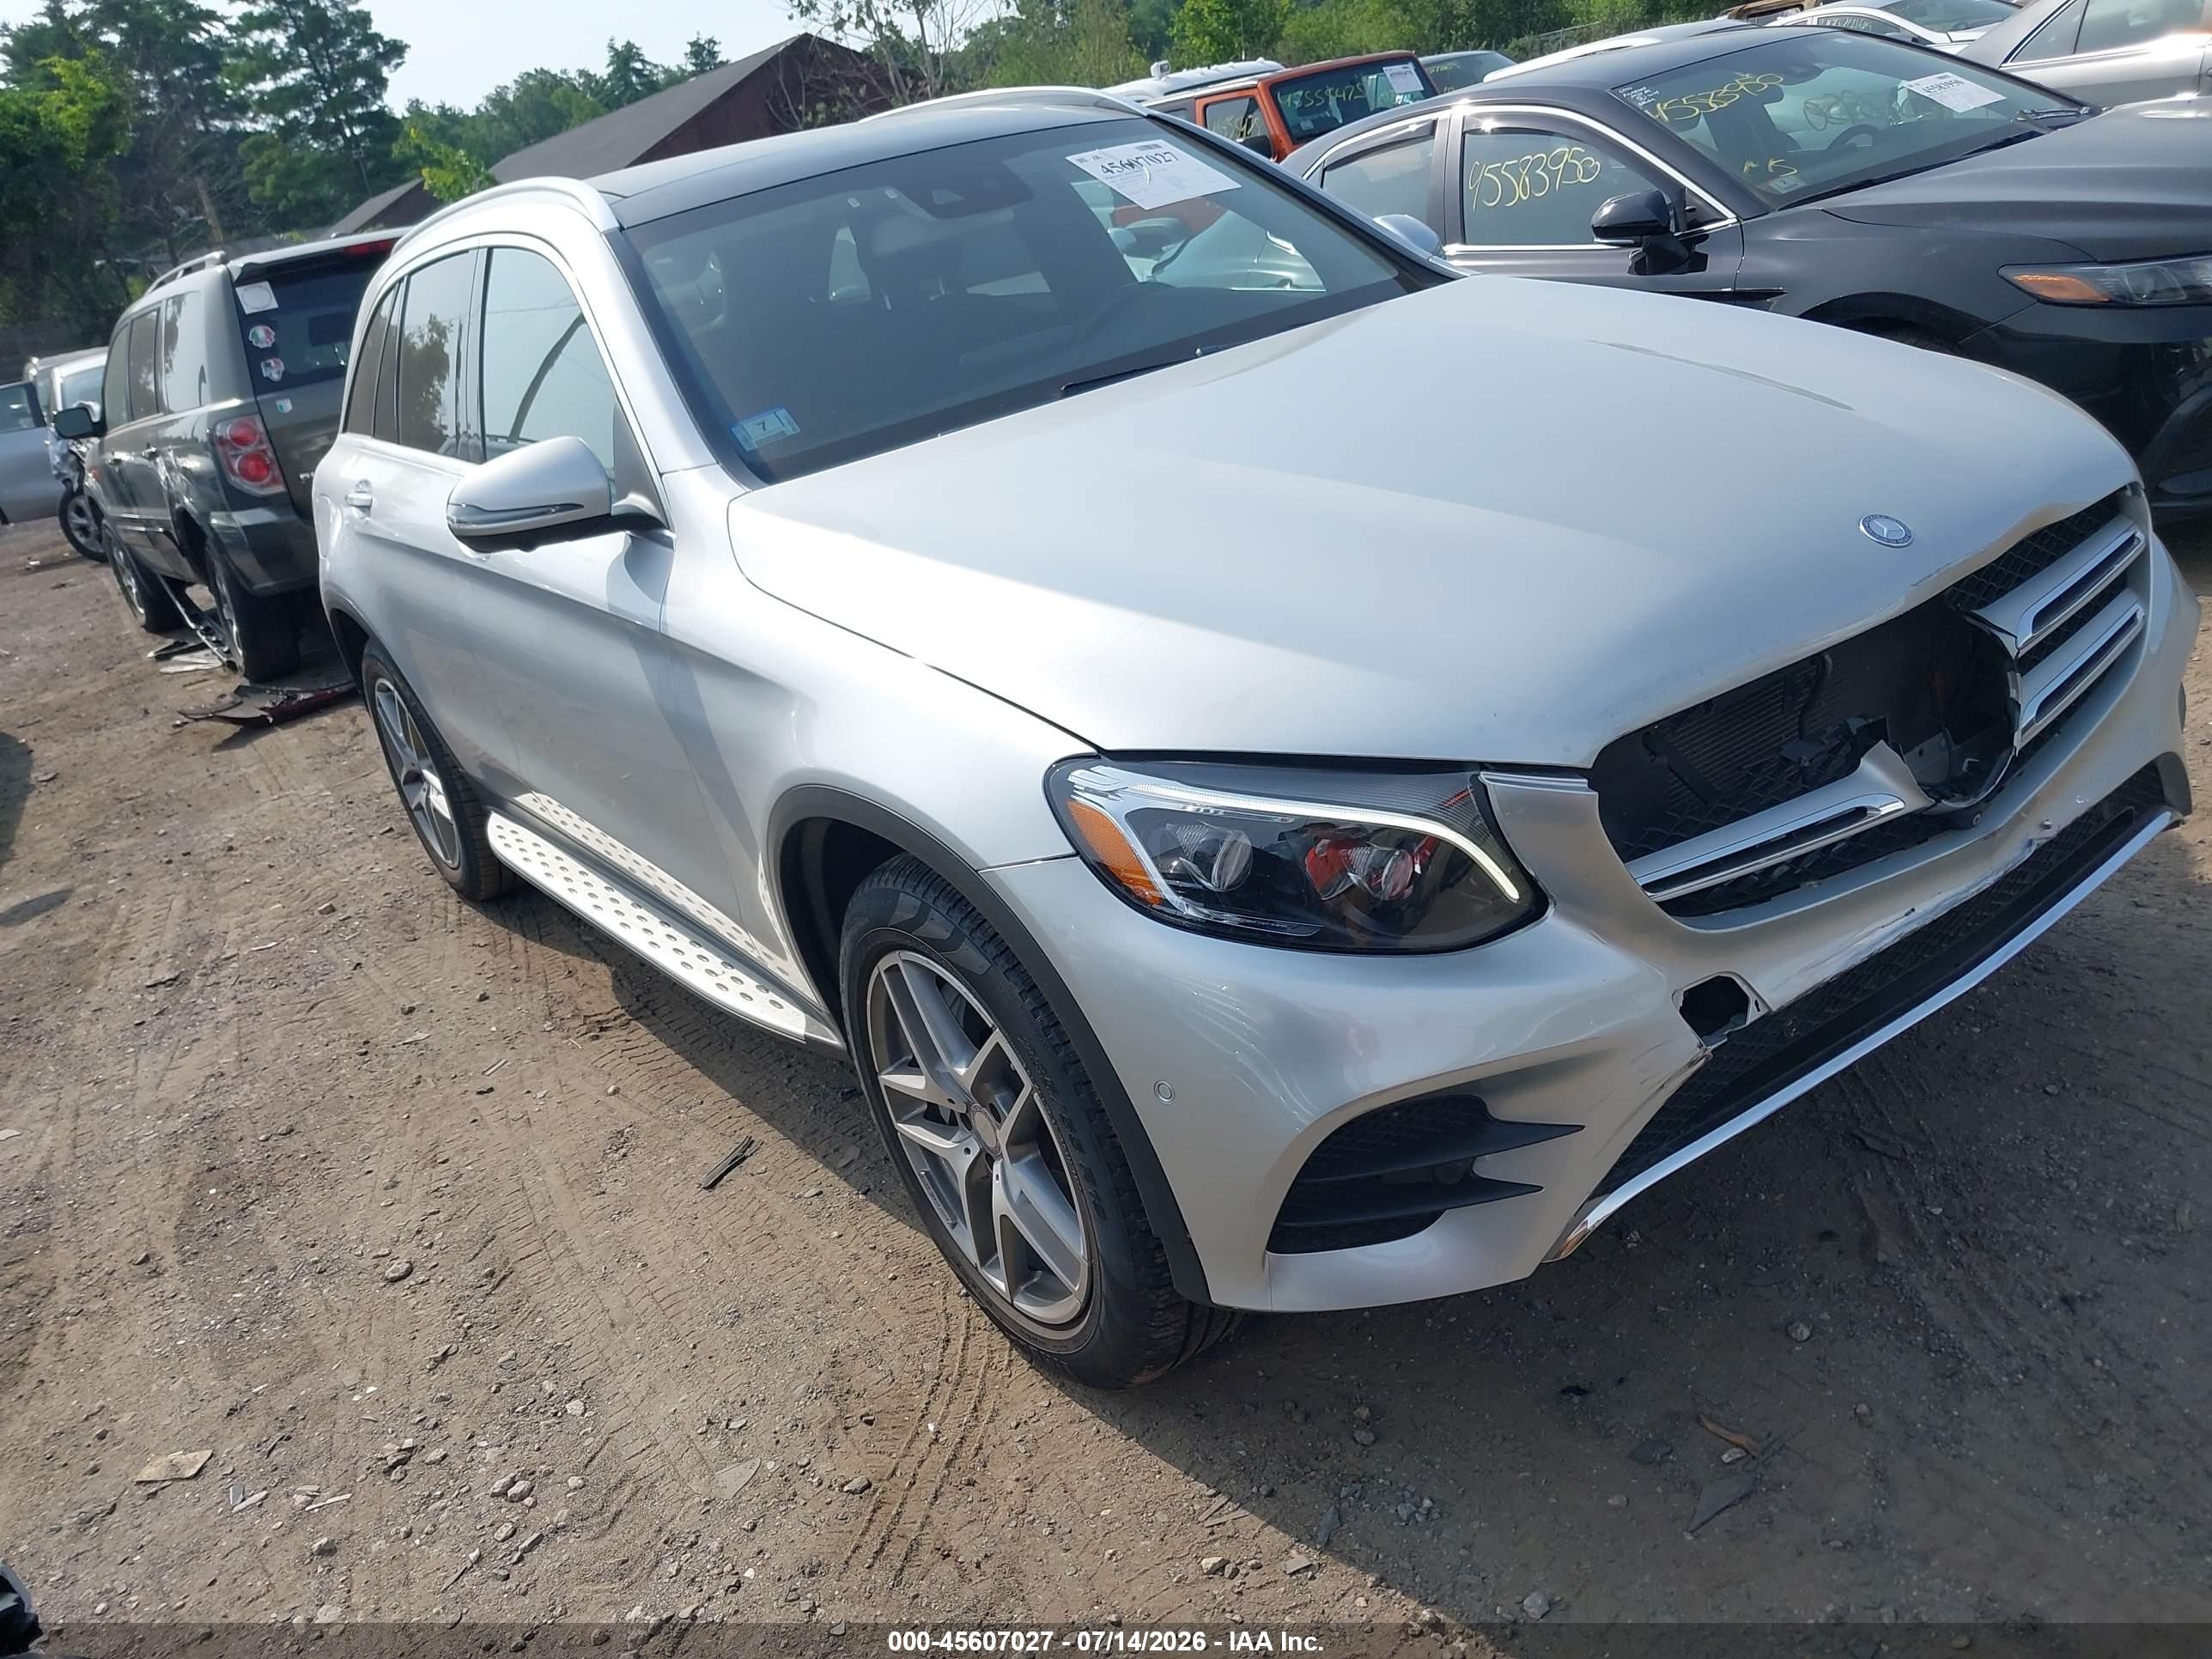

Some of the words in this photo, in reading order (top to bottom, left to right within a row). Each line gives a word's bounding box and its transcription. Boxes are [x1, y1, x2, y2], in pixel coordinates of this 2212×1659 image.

[1100, 151, 1180, 174] 45607027
[1468, 147, 1601, 212] 45583950
[757, 421, 767, 433] 7
